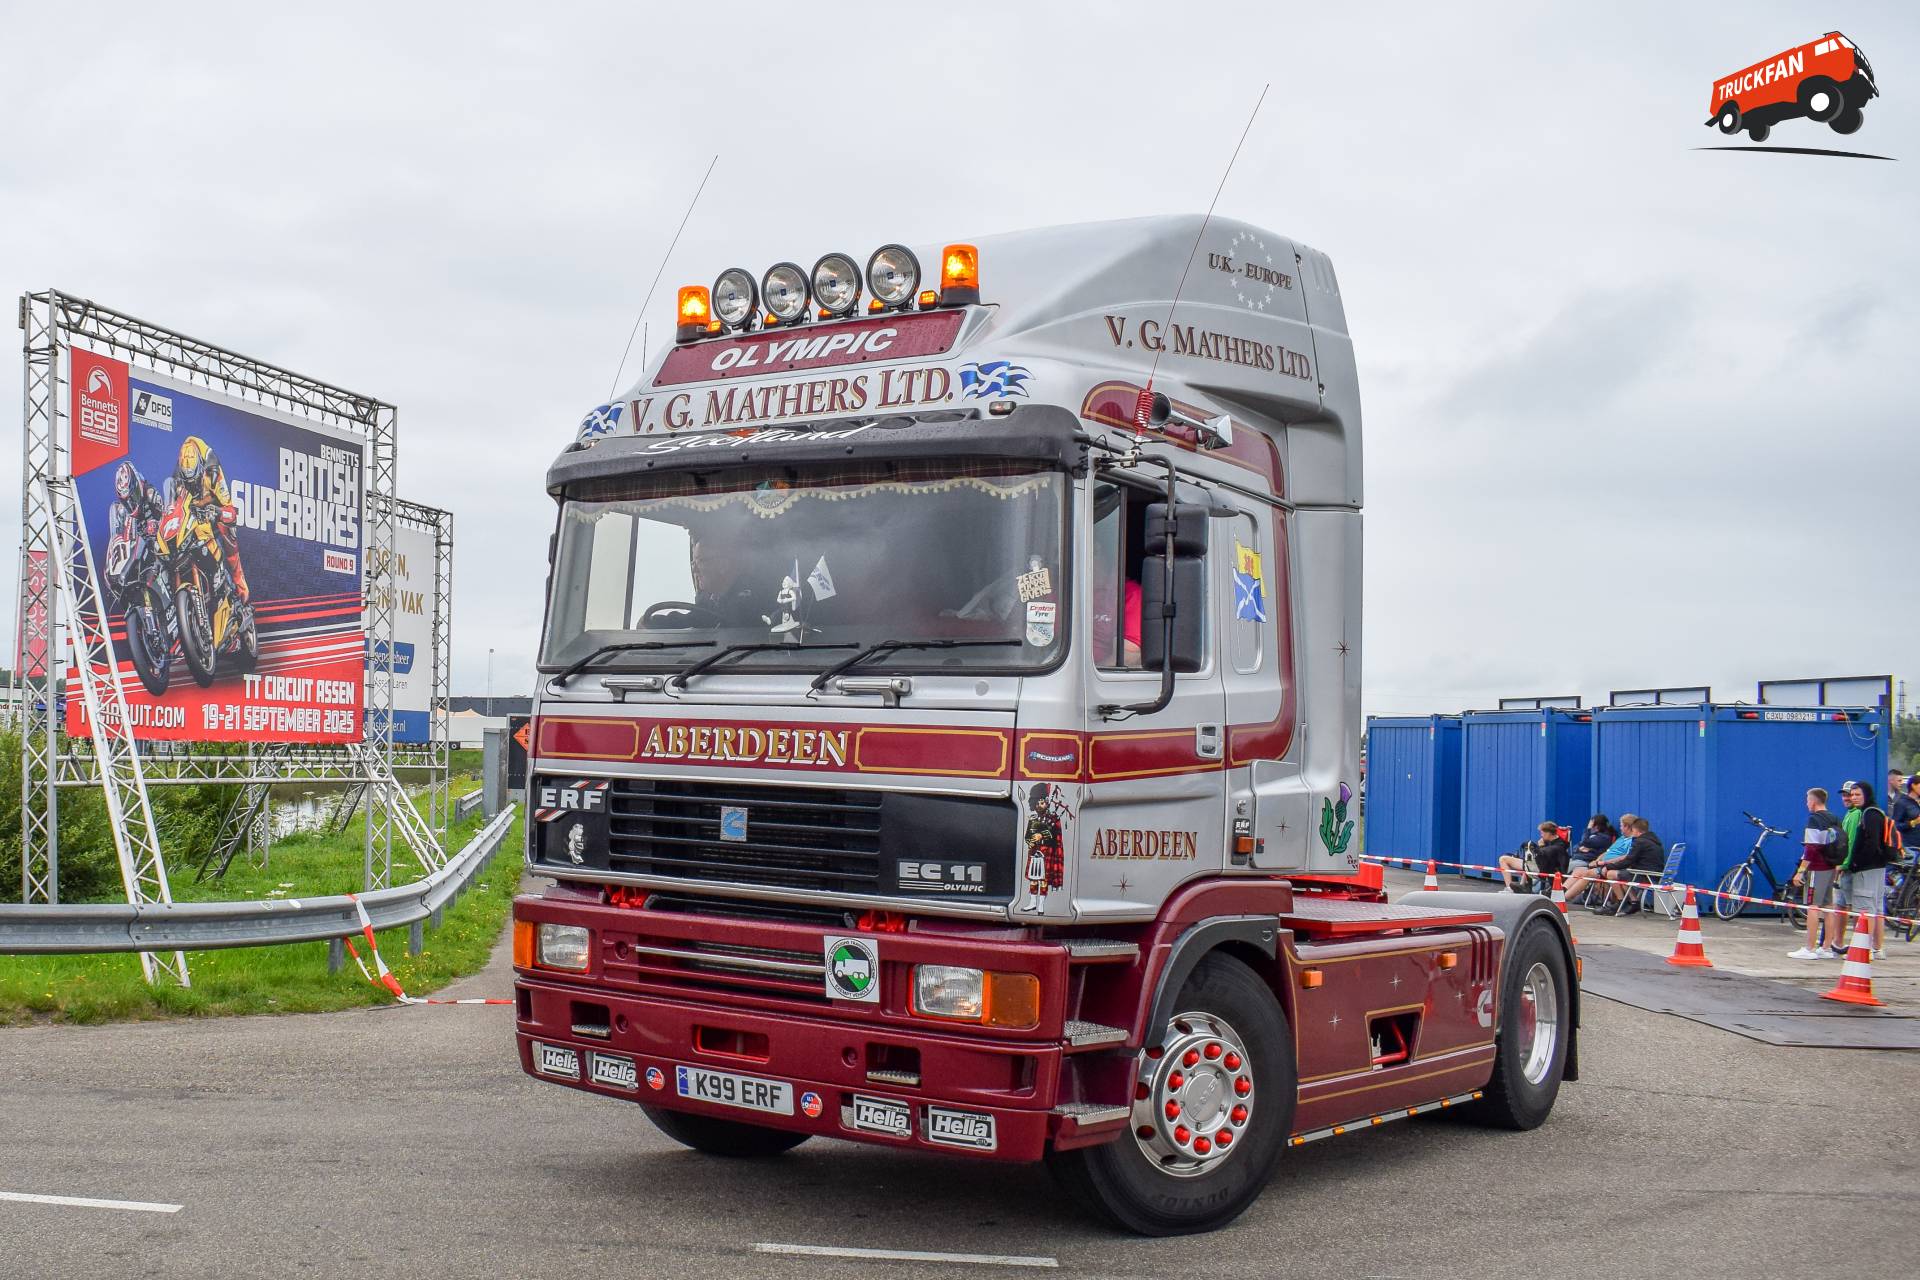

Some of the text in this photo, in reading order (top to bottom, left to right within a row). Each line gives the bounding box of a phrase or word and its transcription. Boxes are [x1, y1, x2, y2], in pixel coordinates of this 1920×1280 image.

[1208, 253, 1235, 274] U.K.
[1246, 263, 1292, 290] EUROPE
[711, 328, 898, 371] OLYMPIC
[1104, 315, 1313, 382] V. G. MATHERS LTD.
[82, 393, 118, 414] Bennetts
[151, 401, 172, 417] DFDS
[629, 367, 954, 433] V. G. MATHERS LTD.
[82, 407, 119, 433] BSB
[631, 422, 879, 454] Scotland
[321, 444, 359, 468] BENNETTS
[280, 447, 358, 508] BRITISH
[231, 480, 358, 548] SUPERBIKES
[326, 555, 354, 571] ROUND 9
[401, 590, 424, 615] VAK
[244, 674, 355, 705] TT CIRCUIT ASSEN
[79, 701, 184, 727] TCIRUIT.COM
[202, 703, 354, 734] 19-21 SEPTEMBER 2025
[641, 724, 852, 767] ABERDEEN
[1036, 753, 1070, 762] SCOTLAND
[541, 788, 603, 810] ERF
[1091, 828, 1199, 861] ABERDEEN
[899, 862, 982, 881] EC 11
[944, 884, 984, 892] OLYMPIC
[546, 1050, 580, 1070] Hella
[597, 1061, 637, 1082] Hella
[696, 1072, 782, 1108] K99 ERF
[860, 1105, 908, 1129] Hella
[935, 1115, 988, 1137] Hella
